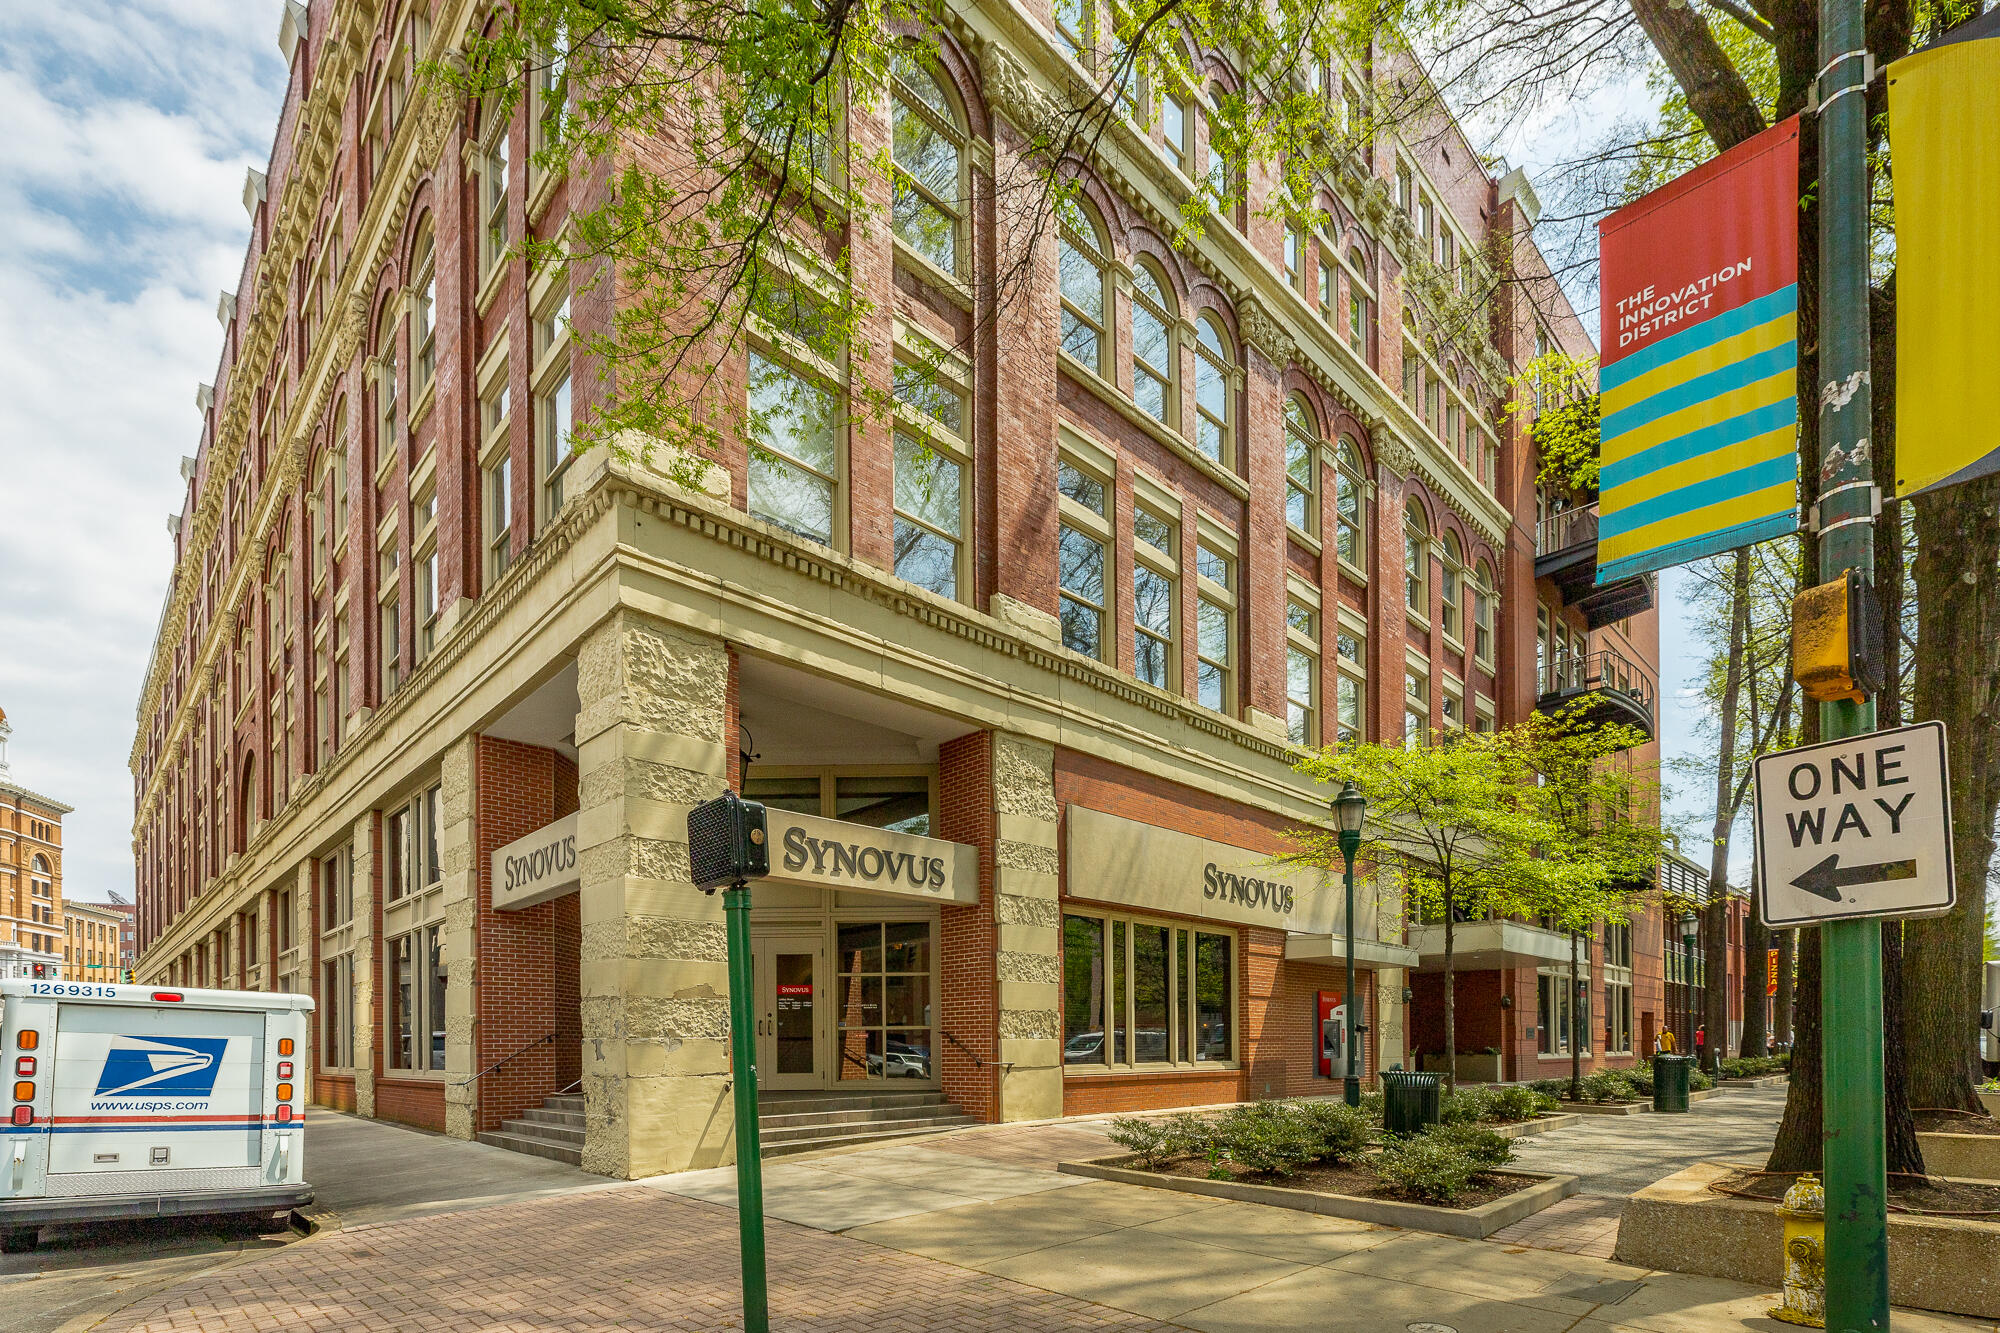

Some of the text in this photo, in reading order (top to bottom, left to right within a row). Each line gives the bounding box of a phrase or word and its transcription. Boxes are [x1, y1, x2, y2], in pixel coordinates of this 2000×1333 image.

[1616, 284, 1655, 314] THE
[1619, 256, 1752, 331] INNOVATION
[1619, 293, 1714, 348] DISTRICT
[1788, 744, 1909, 801] ONE
[1785, 792, 1916, 848] WAY
[505, 834, 576, 891] SYNOVUS
[783, 826, 946, 893] SYNOVUS
[1203, 862, 1294, 914] SYNOVUS
[30, 983, 116, 998] 1269315
[1770, 951, 1778, 985] PIZZA
[91, 1101, 209, 1113] www.usps.com
